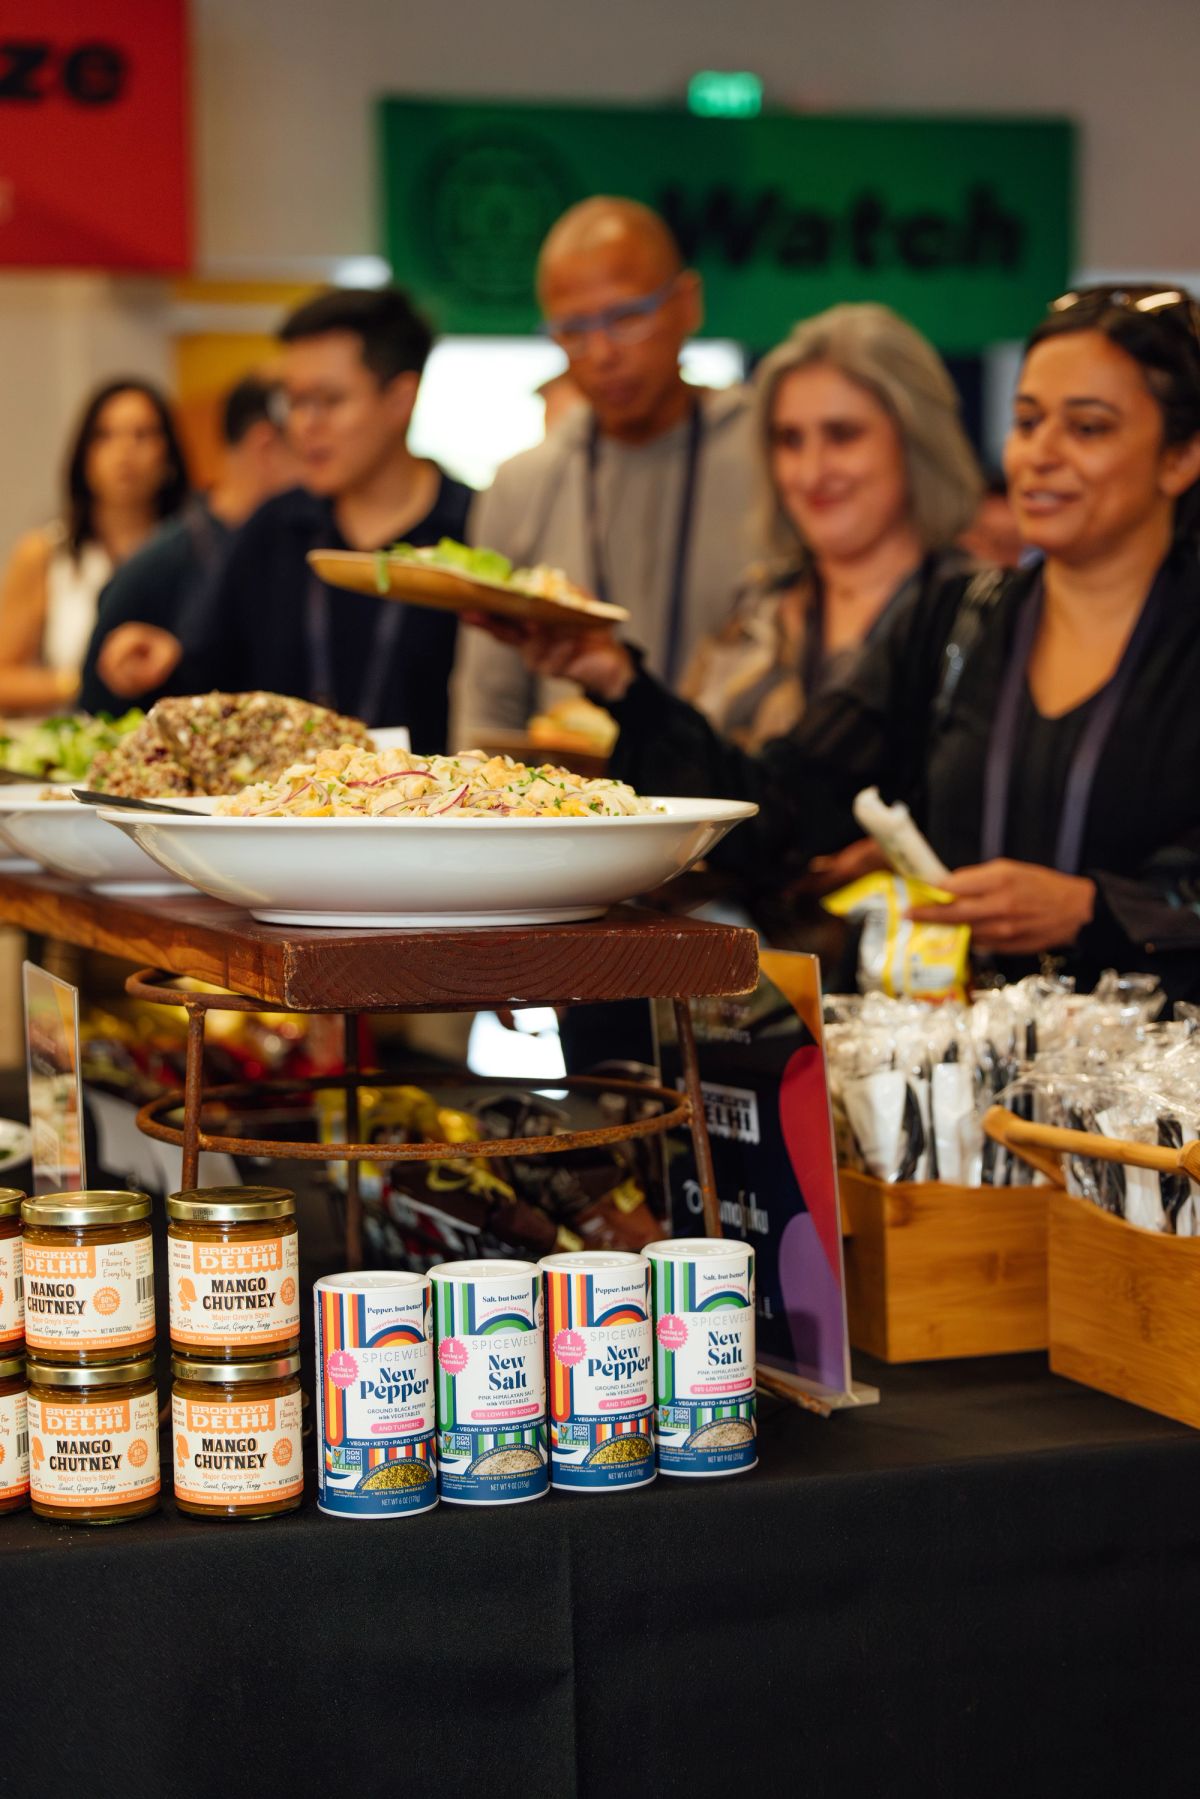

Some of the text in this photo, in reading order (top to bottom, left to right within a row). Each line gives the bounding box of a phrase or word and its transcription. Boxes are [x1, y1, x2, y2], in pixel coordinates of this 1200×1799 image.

[660, 185, 1022, 268] Watch
[24, 1248, 88, 1259] BROOKLYN
[198, 1243, 278, 1255] BROOKLYN
[25, 1258, 88, 1274] DELHI
[200, 1252, 277, 1269] DELHI
[30, 1281, 74, 1298] MANGO
[212, 1277, 266, 1292] MANGO
[202, 1292, 276, 1310] CHUTNEY
[498, 1294, 510, 1302] but
[28, 1300, 86, 1315] CHUTNEY
[368, 1308, 394, 1316] Pepper,
[668, 1319, 674, 1328] 1
[472, 1334, 536, 1350] SPICEWELL
[566, 1334, 571, 1344] 1
[708, 1331, 742, 1346] New
[362, 1346, 426, 1362] SPICEWELL
[449, 1343, 454, 1352] 1
[607, 1346, 640, 1361] New
[338, 1357, 344, 1366] 1
[488, 1354, 526, 1370] New
[708, 1346, 742, 1366] Salt
[588, 1356, 650, 1380] Pepper
[380, 1368, 416, 1384] New
[488, 1370, 526, 1390] Salt
[360, 1378, 429, 1404] Pepper
[618, 1387, 644, 1396] VEGETABLES
[620, 1382, 636, 1390] BLACK
[493, 1392, 524, 1400] HIMALAYAN
[499, 1398, 529, 1406] VEGETABLES
[46, 1406, 124, 1417] BROOKLYN
[191, 1404, 270, 1416] BROOKLYN
[412, 1402, 426, 1410] PEPPER
[192, 1413, 269, 1429] DELHI
[390, 1411, 420, 1420] VEGETABLES
[488, 1410, 508, 1418] LOWER
[46, 1416, 123, 1430] DELHI
[378, 1422, 420, 1432] AND TURMERIC
[56, 1440, 110, 1455] MANGO
[202, 1438, 256, 1453] MANGO
[443, 1448, 470, 1456] VERIFIED
[50, 1454, 122, 1472] CHUTNEY
[194, 1453, 268, 1470] CHUTNEY
[332, 1463, 360, 1471] VERIFIED
[608, 1472, 616, 1480] NET
[382, 1498, 390, 1506] NET
